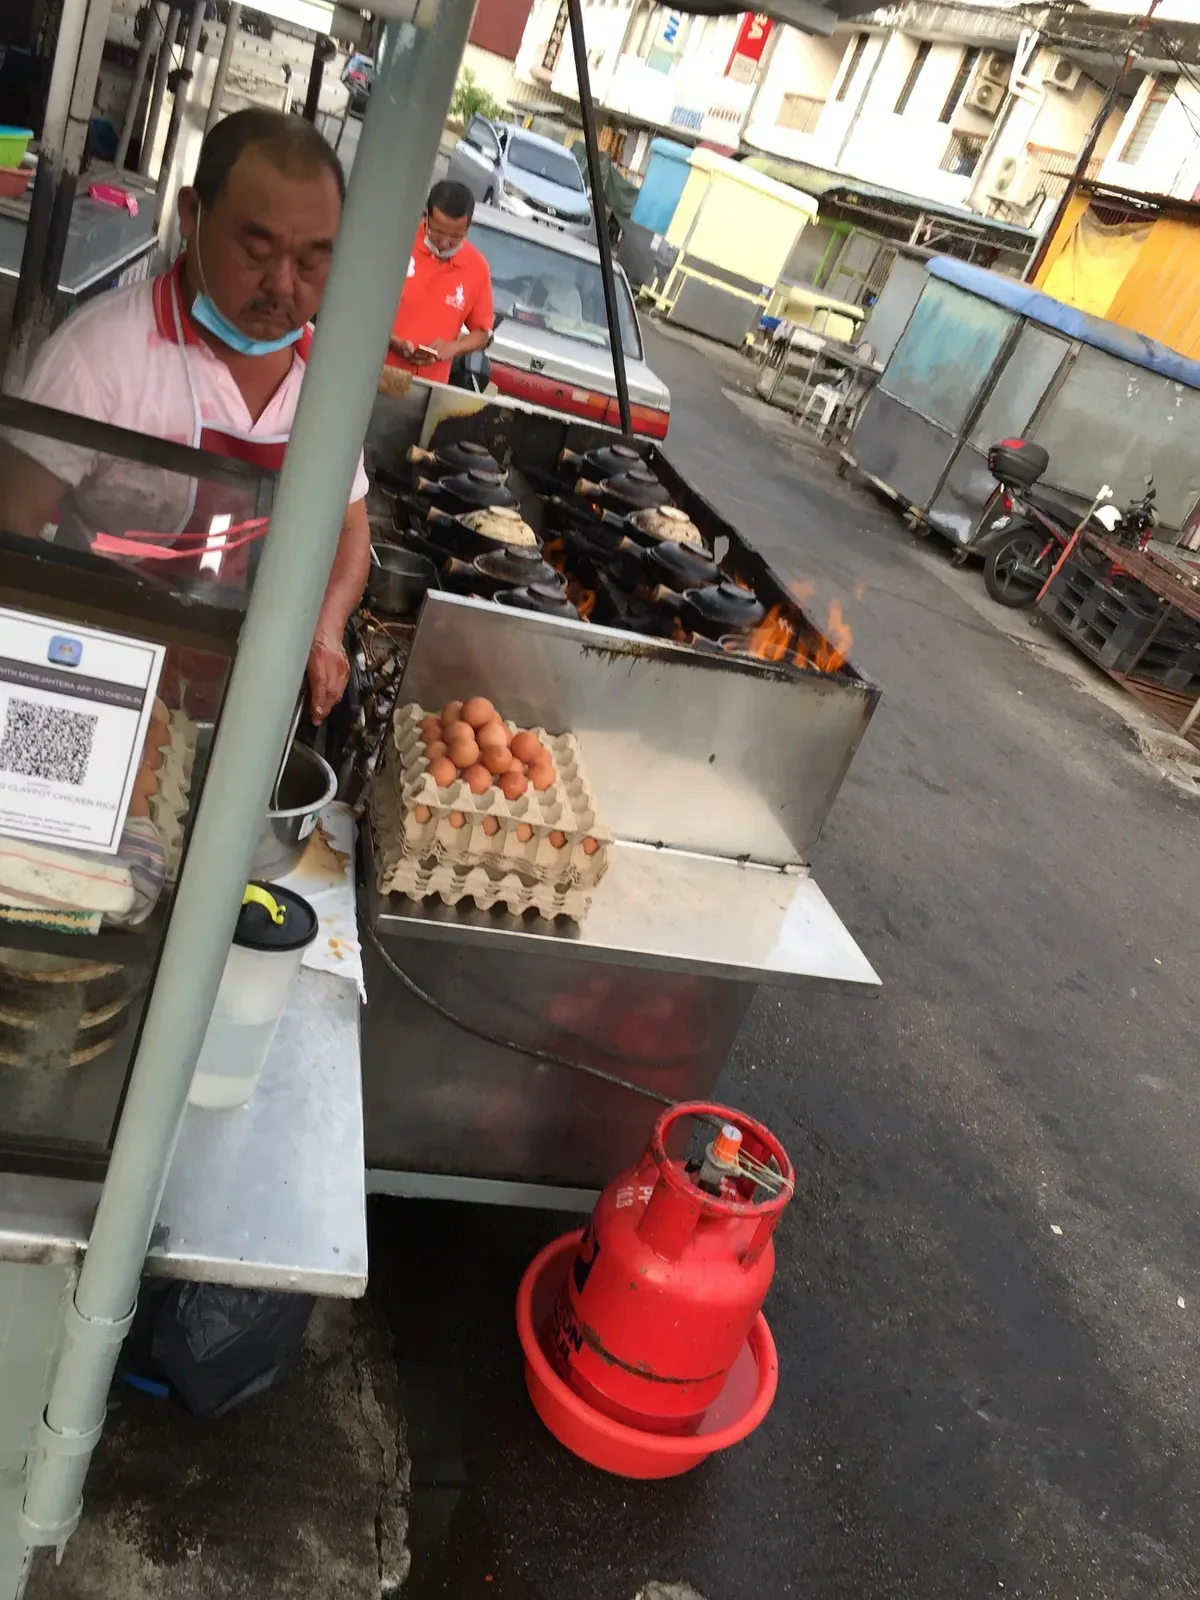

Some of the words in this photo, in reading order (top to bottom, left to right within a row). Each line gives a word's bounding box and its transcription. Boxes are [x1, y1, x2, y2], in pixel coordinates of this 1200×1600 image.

[76, 684, 93, 693] APP
[94, 687, 104, 696] TO
[8, 784, 51, 797] CLAYPOT
[53, 792, 94, 806] CHICKEN
